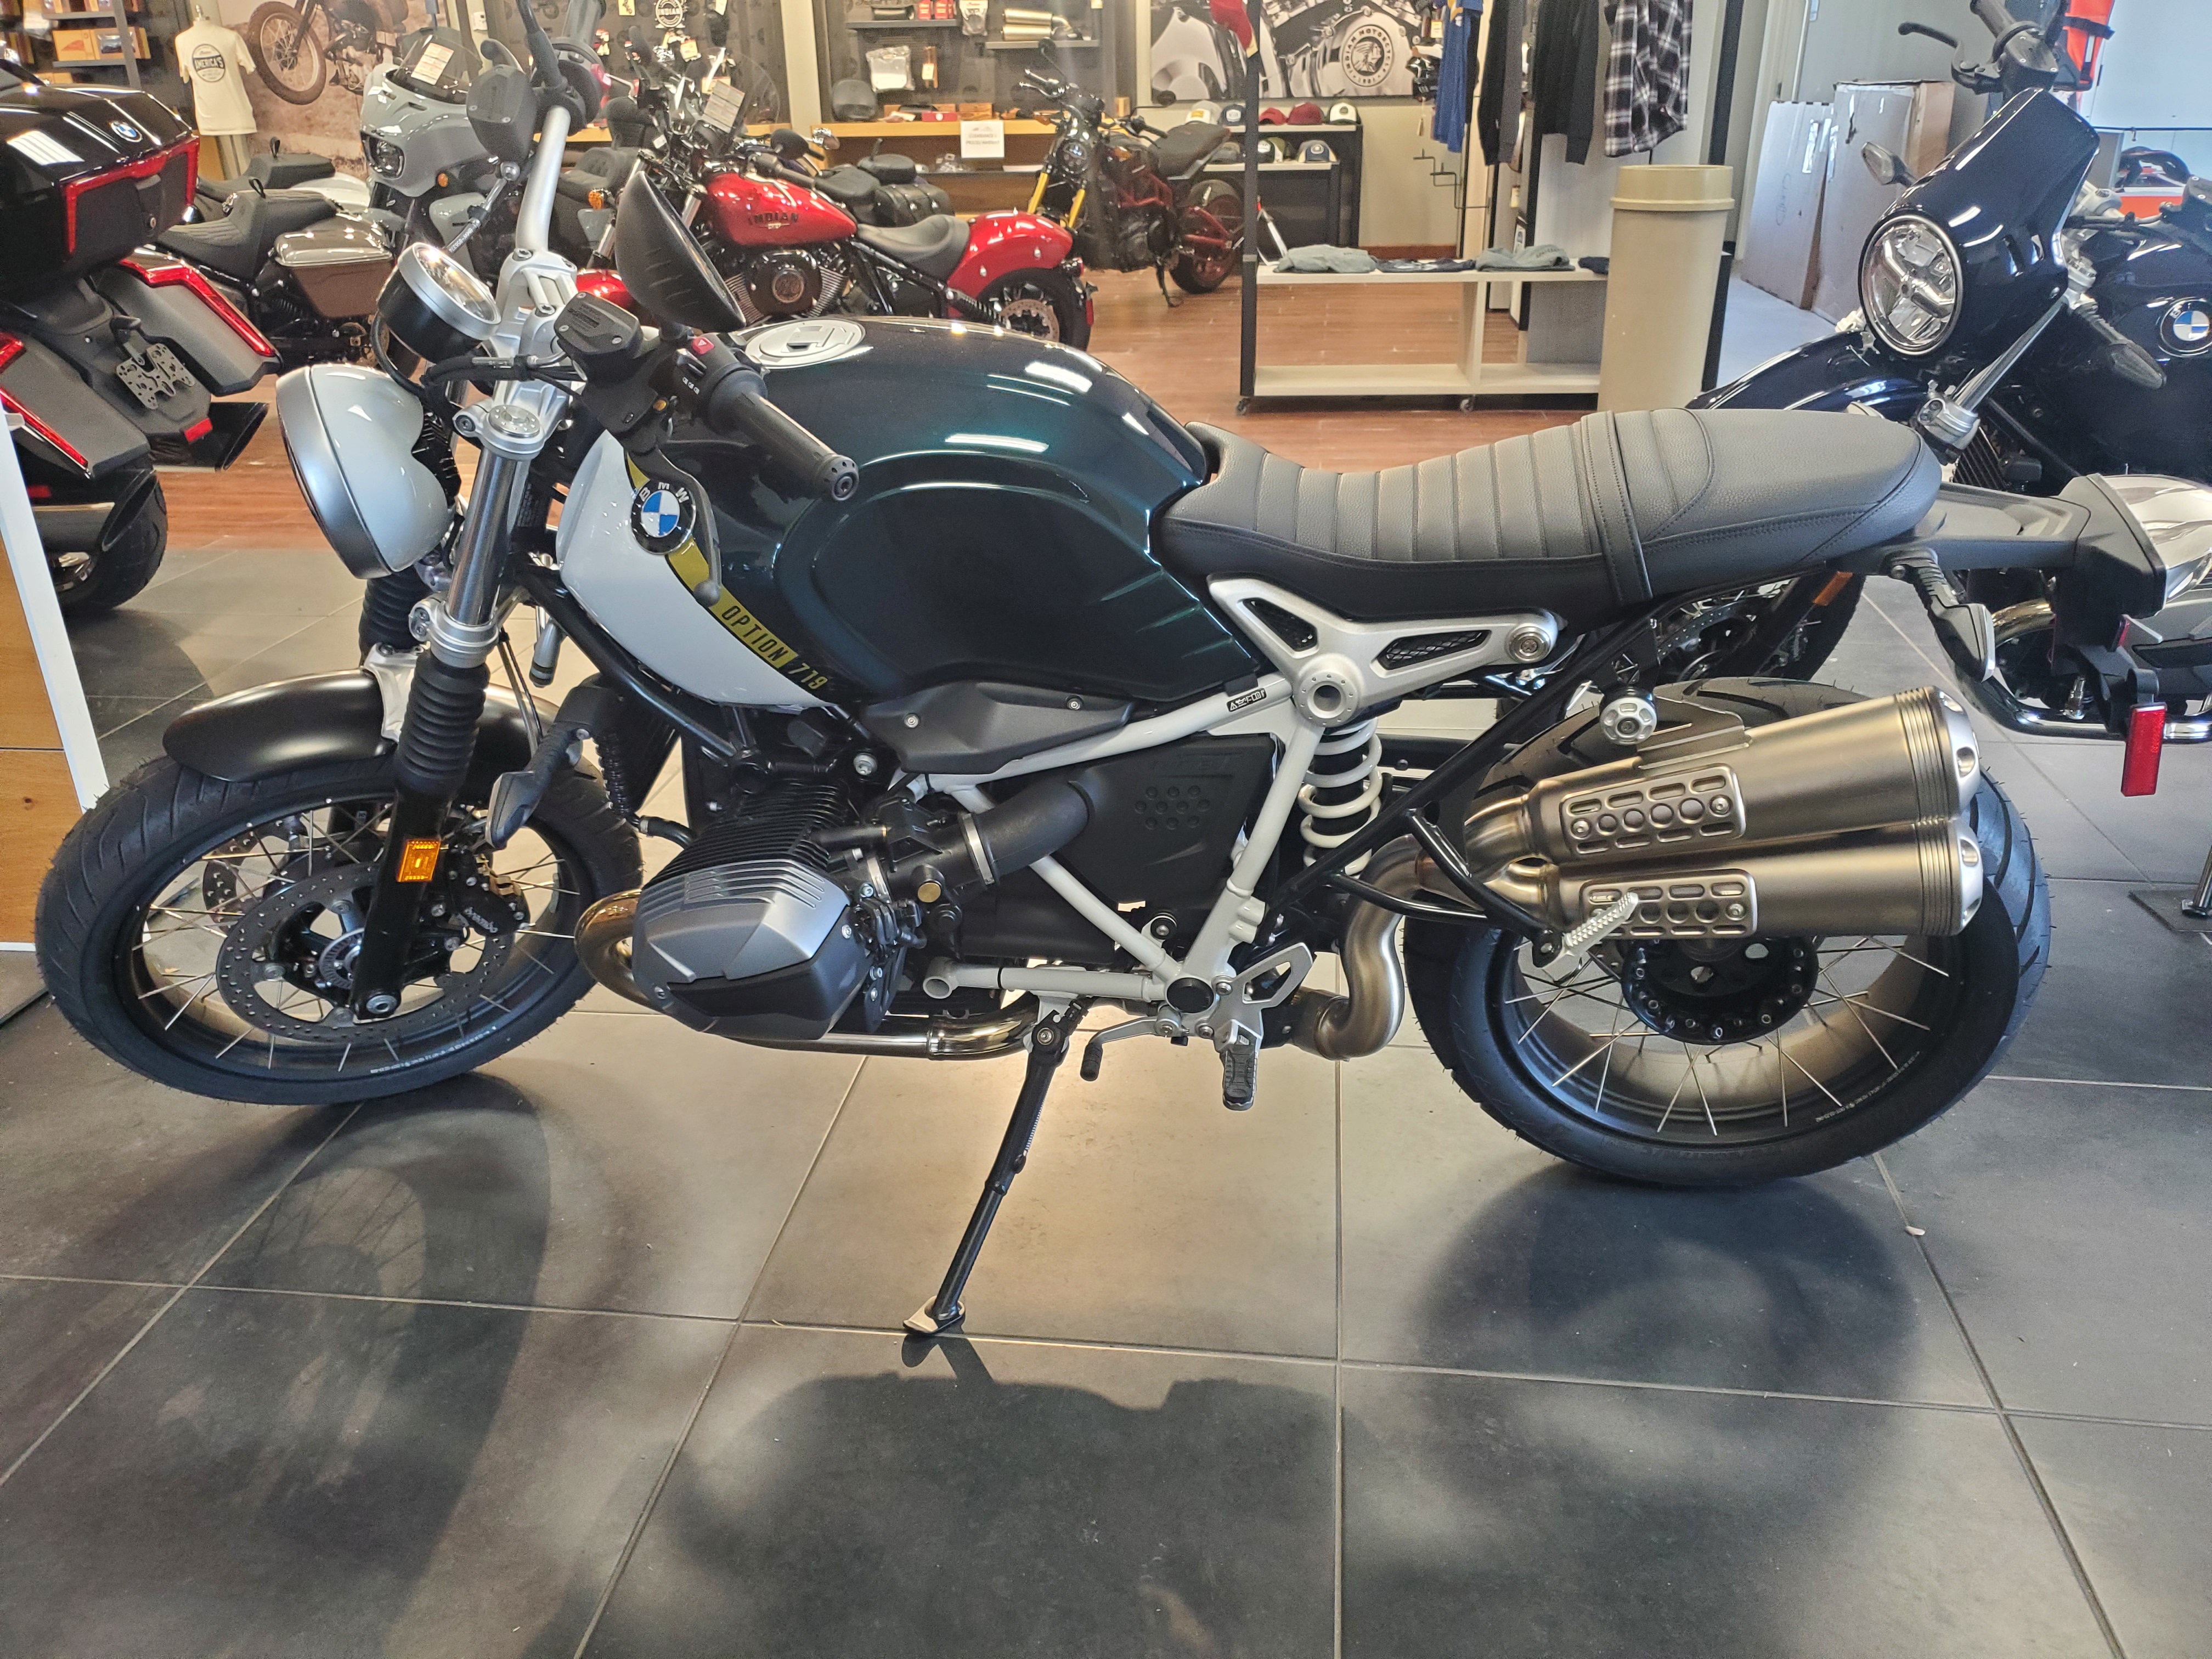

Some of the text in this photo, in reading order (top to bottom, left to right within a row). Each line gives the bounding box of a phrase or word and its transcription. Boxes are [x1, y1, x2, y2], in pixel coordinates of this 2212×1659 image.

[639, 482, 690, 503] BMW
[721, 605, 828, 690] OPTION 719
